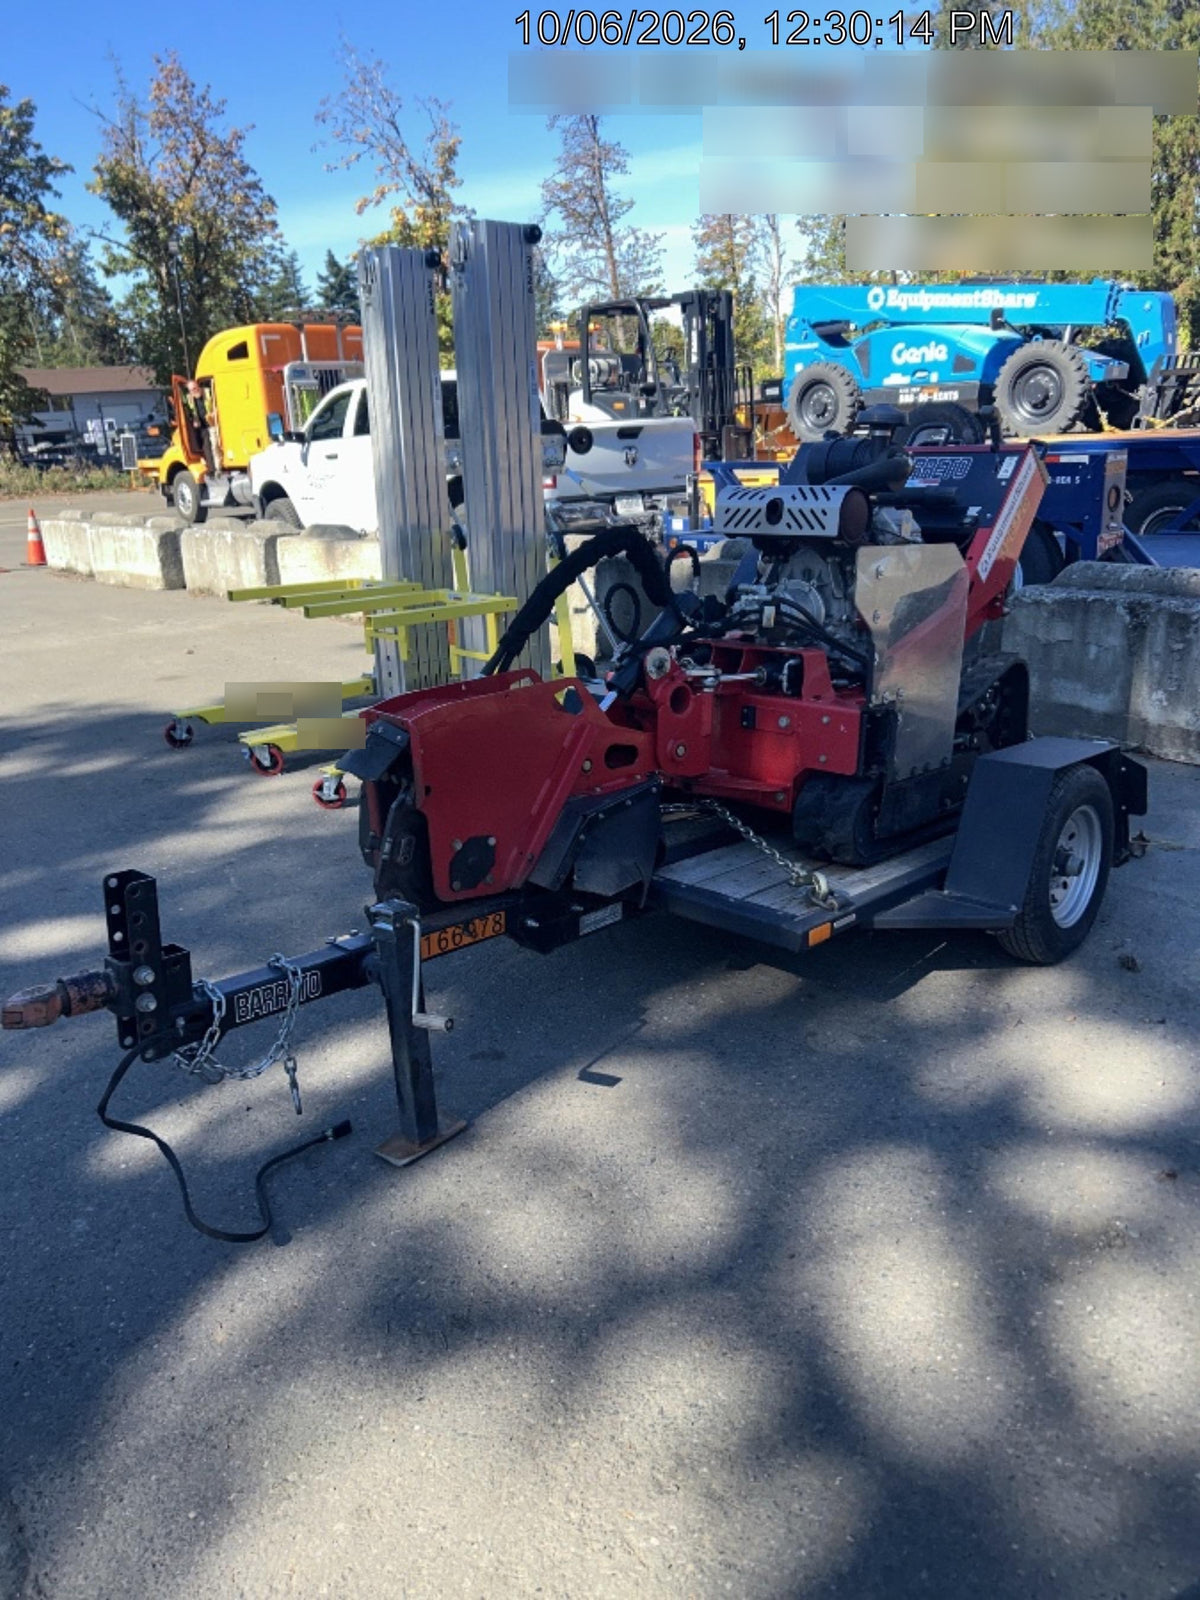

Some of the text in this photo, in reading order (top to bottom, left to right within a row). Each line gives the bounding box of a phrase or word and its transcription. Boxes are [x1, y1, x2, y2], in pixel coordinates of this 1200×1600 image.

[886, 288, 1038, 311] EquipmentShare
[891, 341, 948, 365] Genie
[234, 970, 321, 1023] BARRTO
